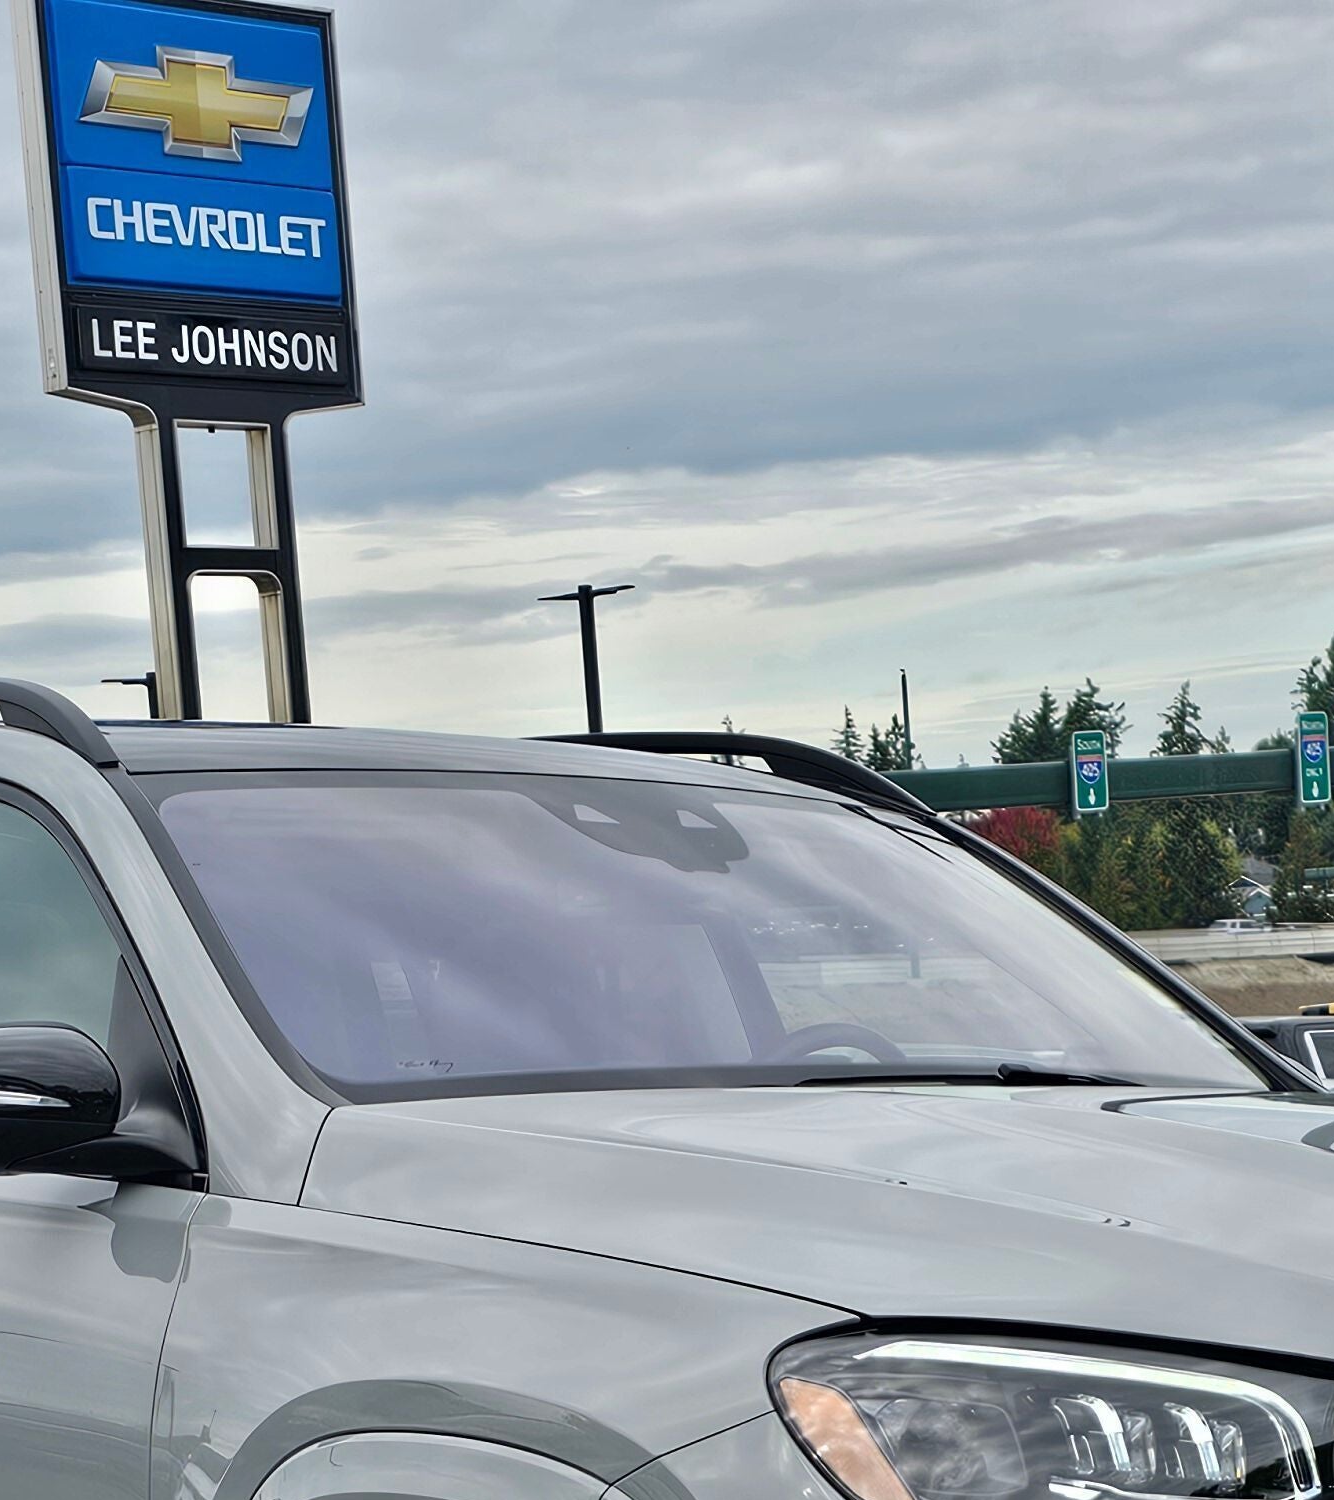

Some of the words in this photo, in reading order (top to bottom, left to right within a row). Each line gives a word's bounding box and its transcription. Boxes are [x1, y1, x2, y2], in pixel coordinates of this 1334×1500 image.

[87, 197, 326, 258] CHEVROLET
[91, 318, 159, 360] LEE
[171, 325, 338, 373] JOHNSON
